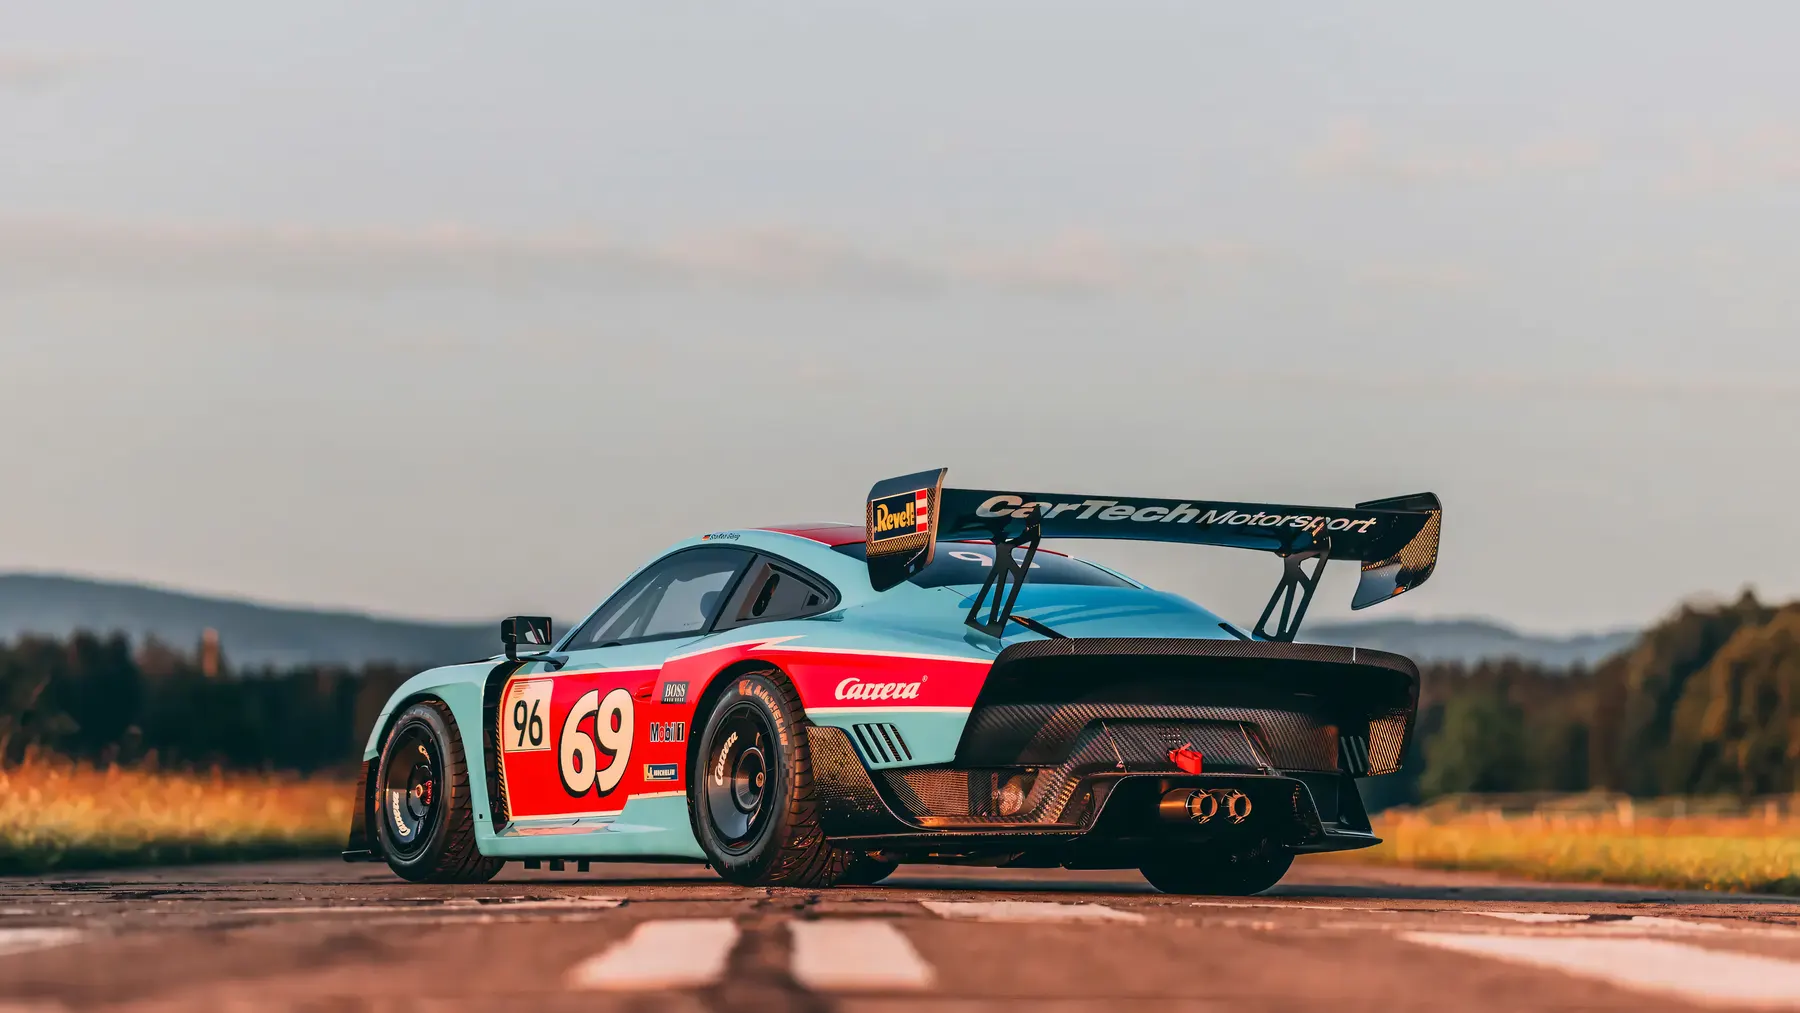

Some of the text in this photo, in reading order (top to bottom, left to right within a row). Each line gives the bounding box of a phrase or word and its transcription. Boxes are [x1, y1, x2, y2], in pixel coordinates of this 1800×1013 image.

[874, 501, 915, 533] Revell
[975, 495, 1377, 533] CarTech Motorsport
[664, 683, 686, 698] BOSS
[834, 677, 921, 701] Carrera
[513, 699, 544, 747] 96
[650, 722, 685, 742] Mobil 1
[753, 684, 789, 746] MICHELIN
[557, 687, 635, 798] 69
[714, 731, 739, 786] Carrera
